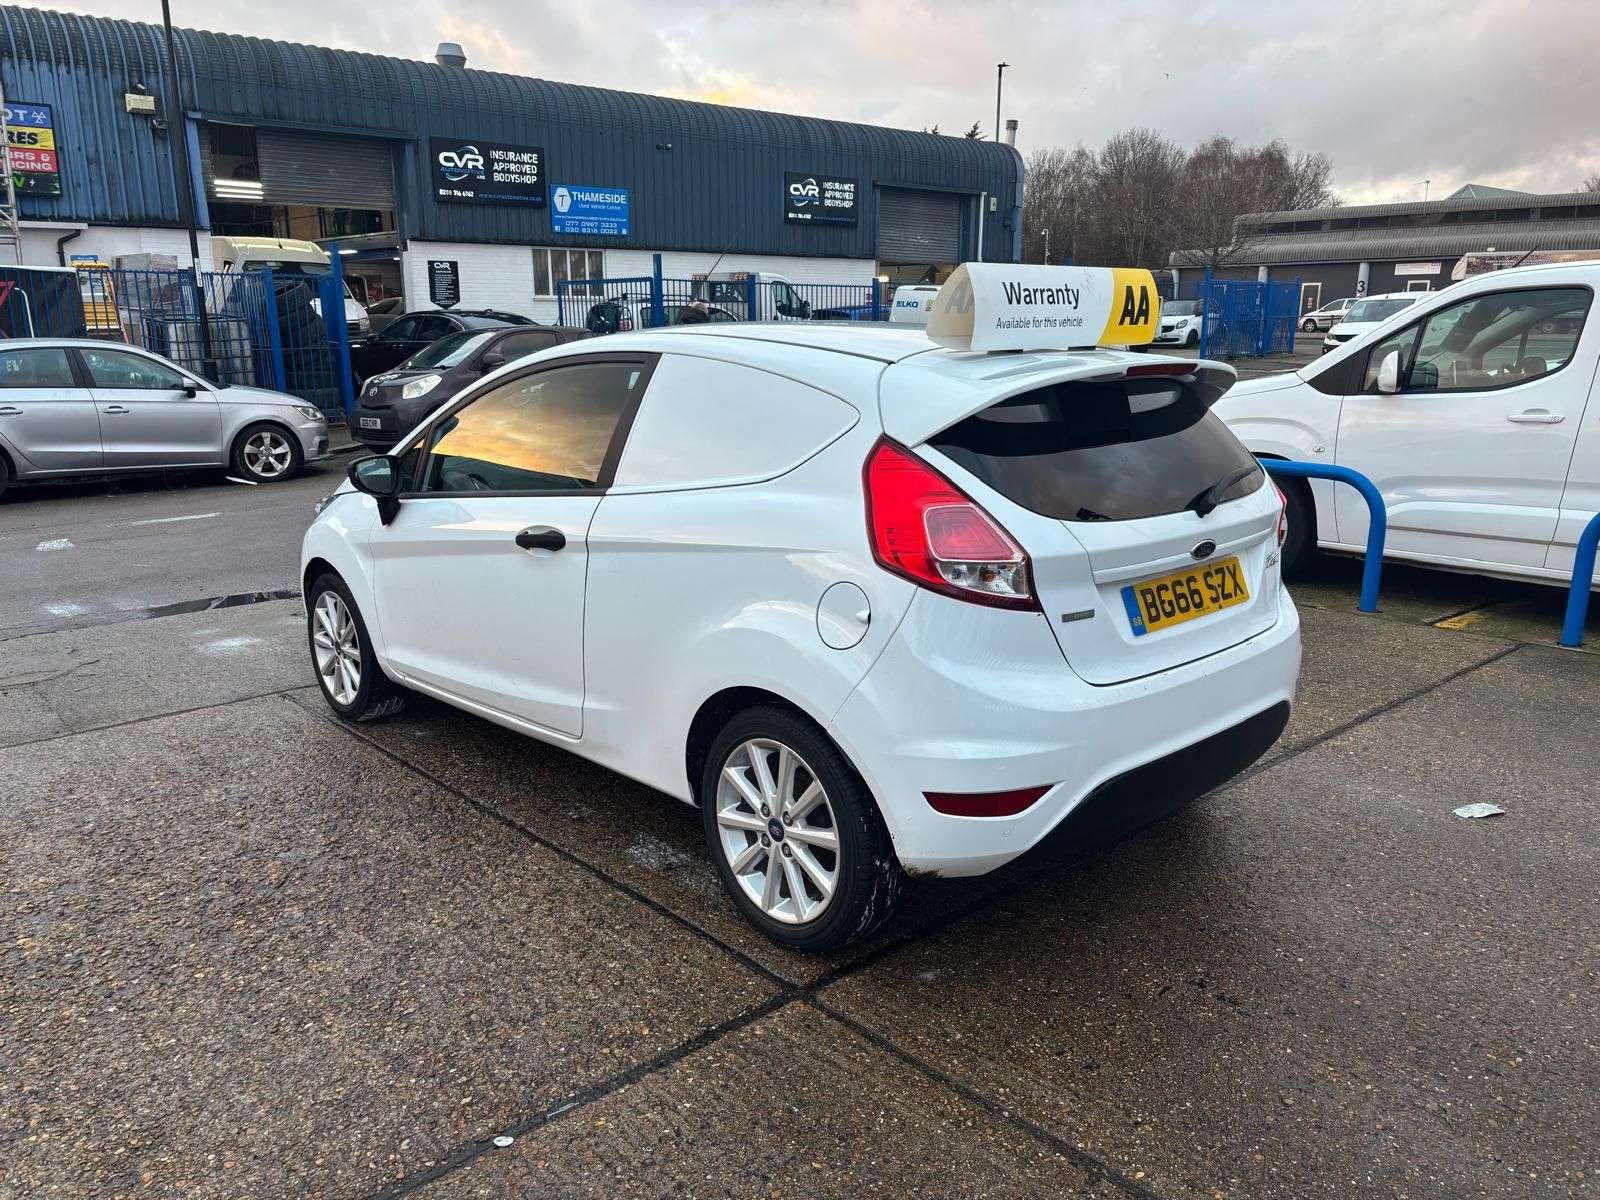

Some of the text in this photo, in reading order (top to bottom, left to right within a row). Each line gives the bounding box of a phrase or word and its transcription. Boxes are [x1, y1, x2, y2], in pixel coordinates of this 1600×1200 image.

[3, 108, 28, 121] OT
[40, 153, 50, 161] &
[438, 151, 485, 170] CVR
[489, 150, 539, 163] INSURANCE
[492, 161, 538, 174] APPROVED
[493, 172, 538, 184] BODYSHOP
[789, 184, 820, 196] CVR
[822, 182, 855, 191] INSURANCE
[572, 192, 627, 204] THAMESIDE
[824, 190, 854, 200] APPROVED
[824, 199, 854, 208] BODYSHOP
[434, 262, 451, 270] CVR
[1357, 280, 1365, 293] 3
[1003, 281, 1080, 309] Warranty
[1118, 285, 1150, 326] AA
[995, 316, 1083, 329] Available for this vehicle
[1140, 563, 1244, 624] BG66 SZX
